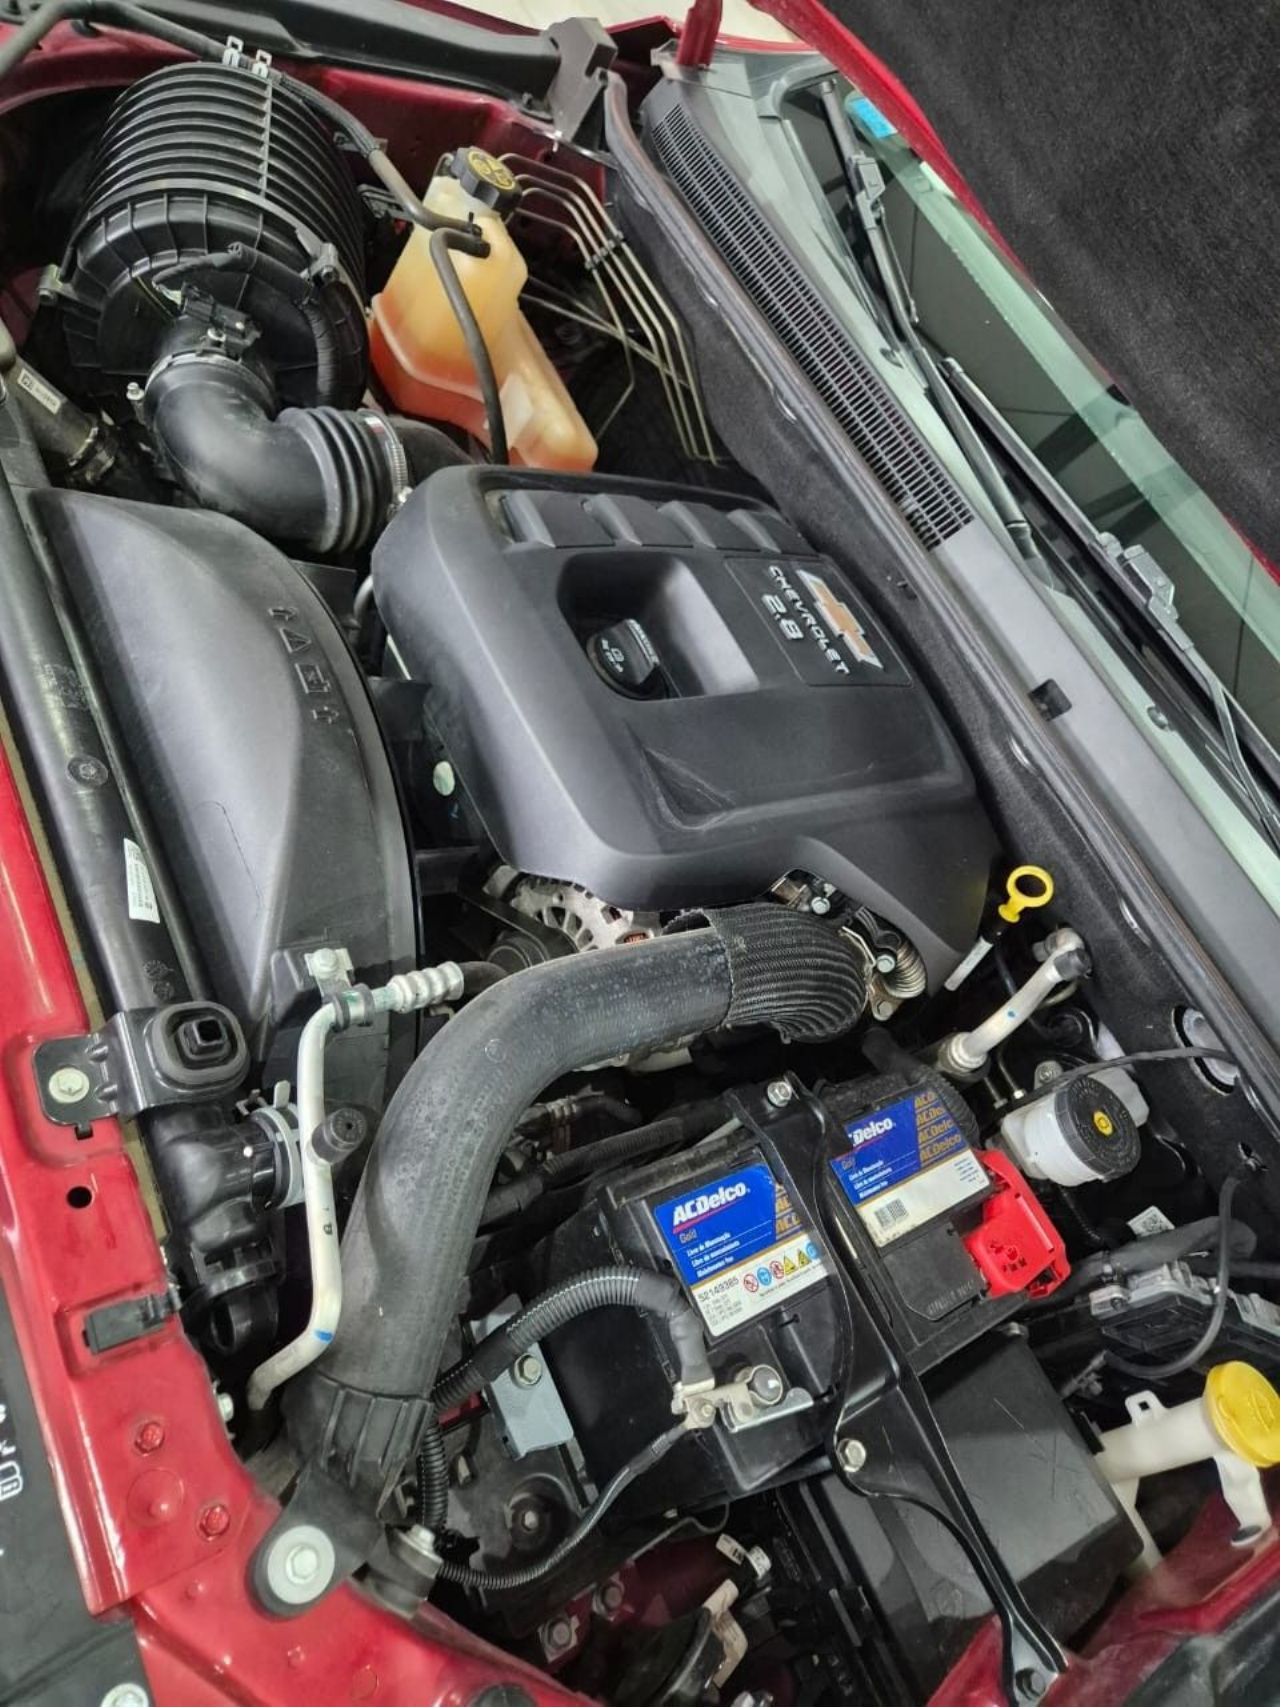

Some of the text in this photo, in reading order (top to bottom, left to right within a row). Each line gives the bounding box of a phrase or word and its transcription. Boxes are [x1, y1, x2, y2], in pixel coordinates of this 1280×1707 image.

[761, 594, 805, 640] 2.8
[768, 565, 851, 675] CHEVROLET
[848, 1117, 894, 1148] Delco
[673, 1182, 747, 1227] ACDelco
[679, 1228, 698, 1245] Gold
